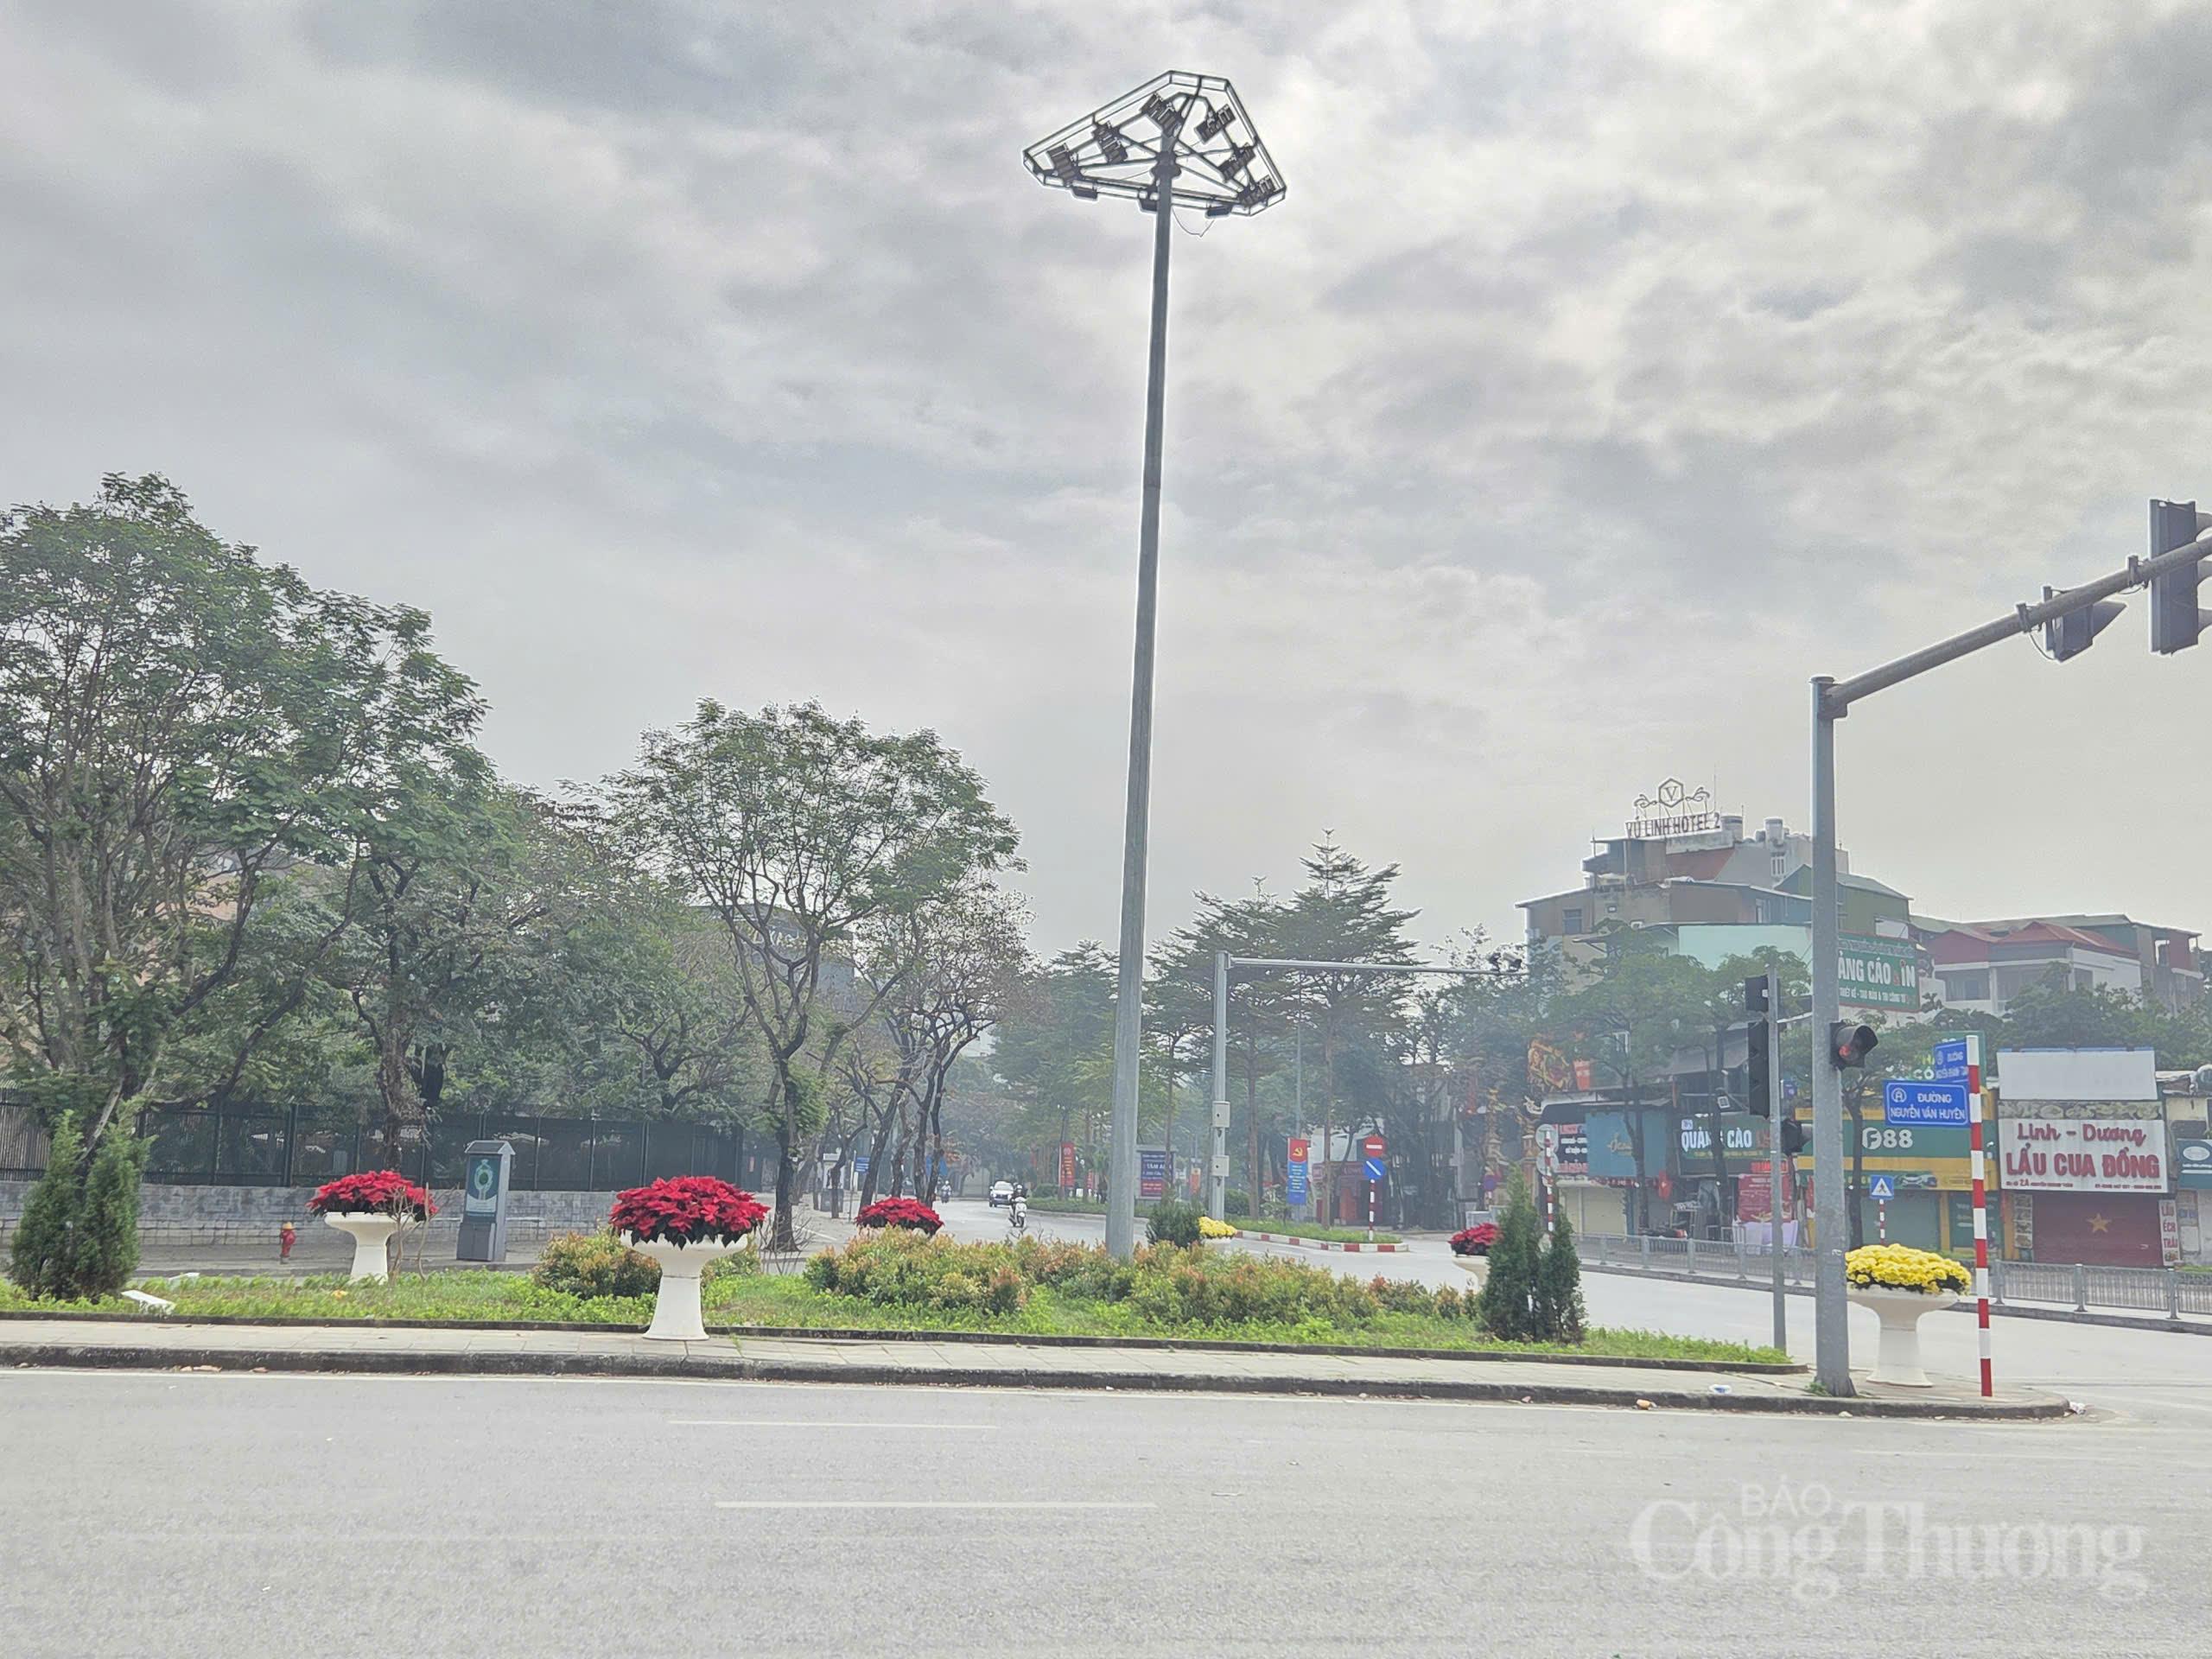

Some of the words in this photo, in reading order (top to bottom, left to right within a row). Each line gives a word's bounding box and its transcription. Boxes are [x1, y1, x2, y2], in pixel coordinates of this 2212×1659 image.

[1645, 817, 1671, 837] LINH
[1673, 813, 1710, 834] HOTEL
[1714, 812, 1721, 830] 2
[1867, 957, 1891, 984] CÁO
[1916, 1090, 1953, 1103] ĐƯỜNG
[1890, 1104, 1920, 1119] NGUYỄN
[2017, 1123, 2062, 1141] Linh
[2082, 1123, 2147, 1147] Dương
[2005, 1141, 2047, 1176] LẨU
[2054, 1153, 2097, 1178] CUA
[2101, 1147, 2160, 1179] ĐỒNG
